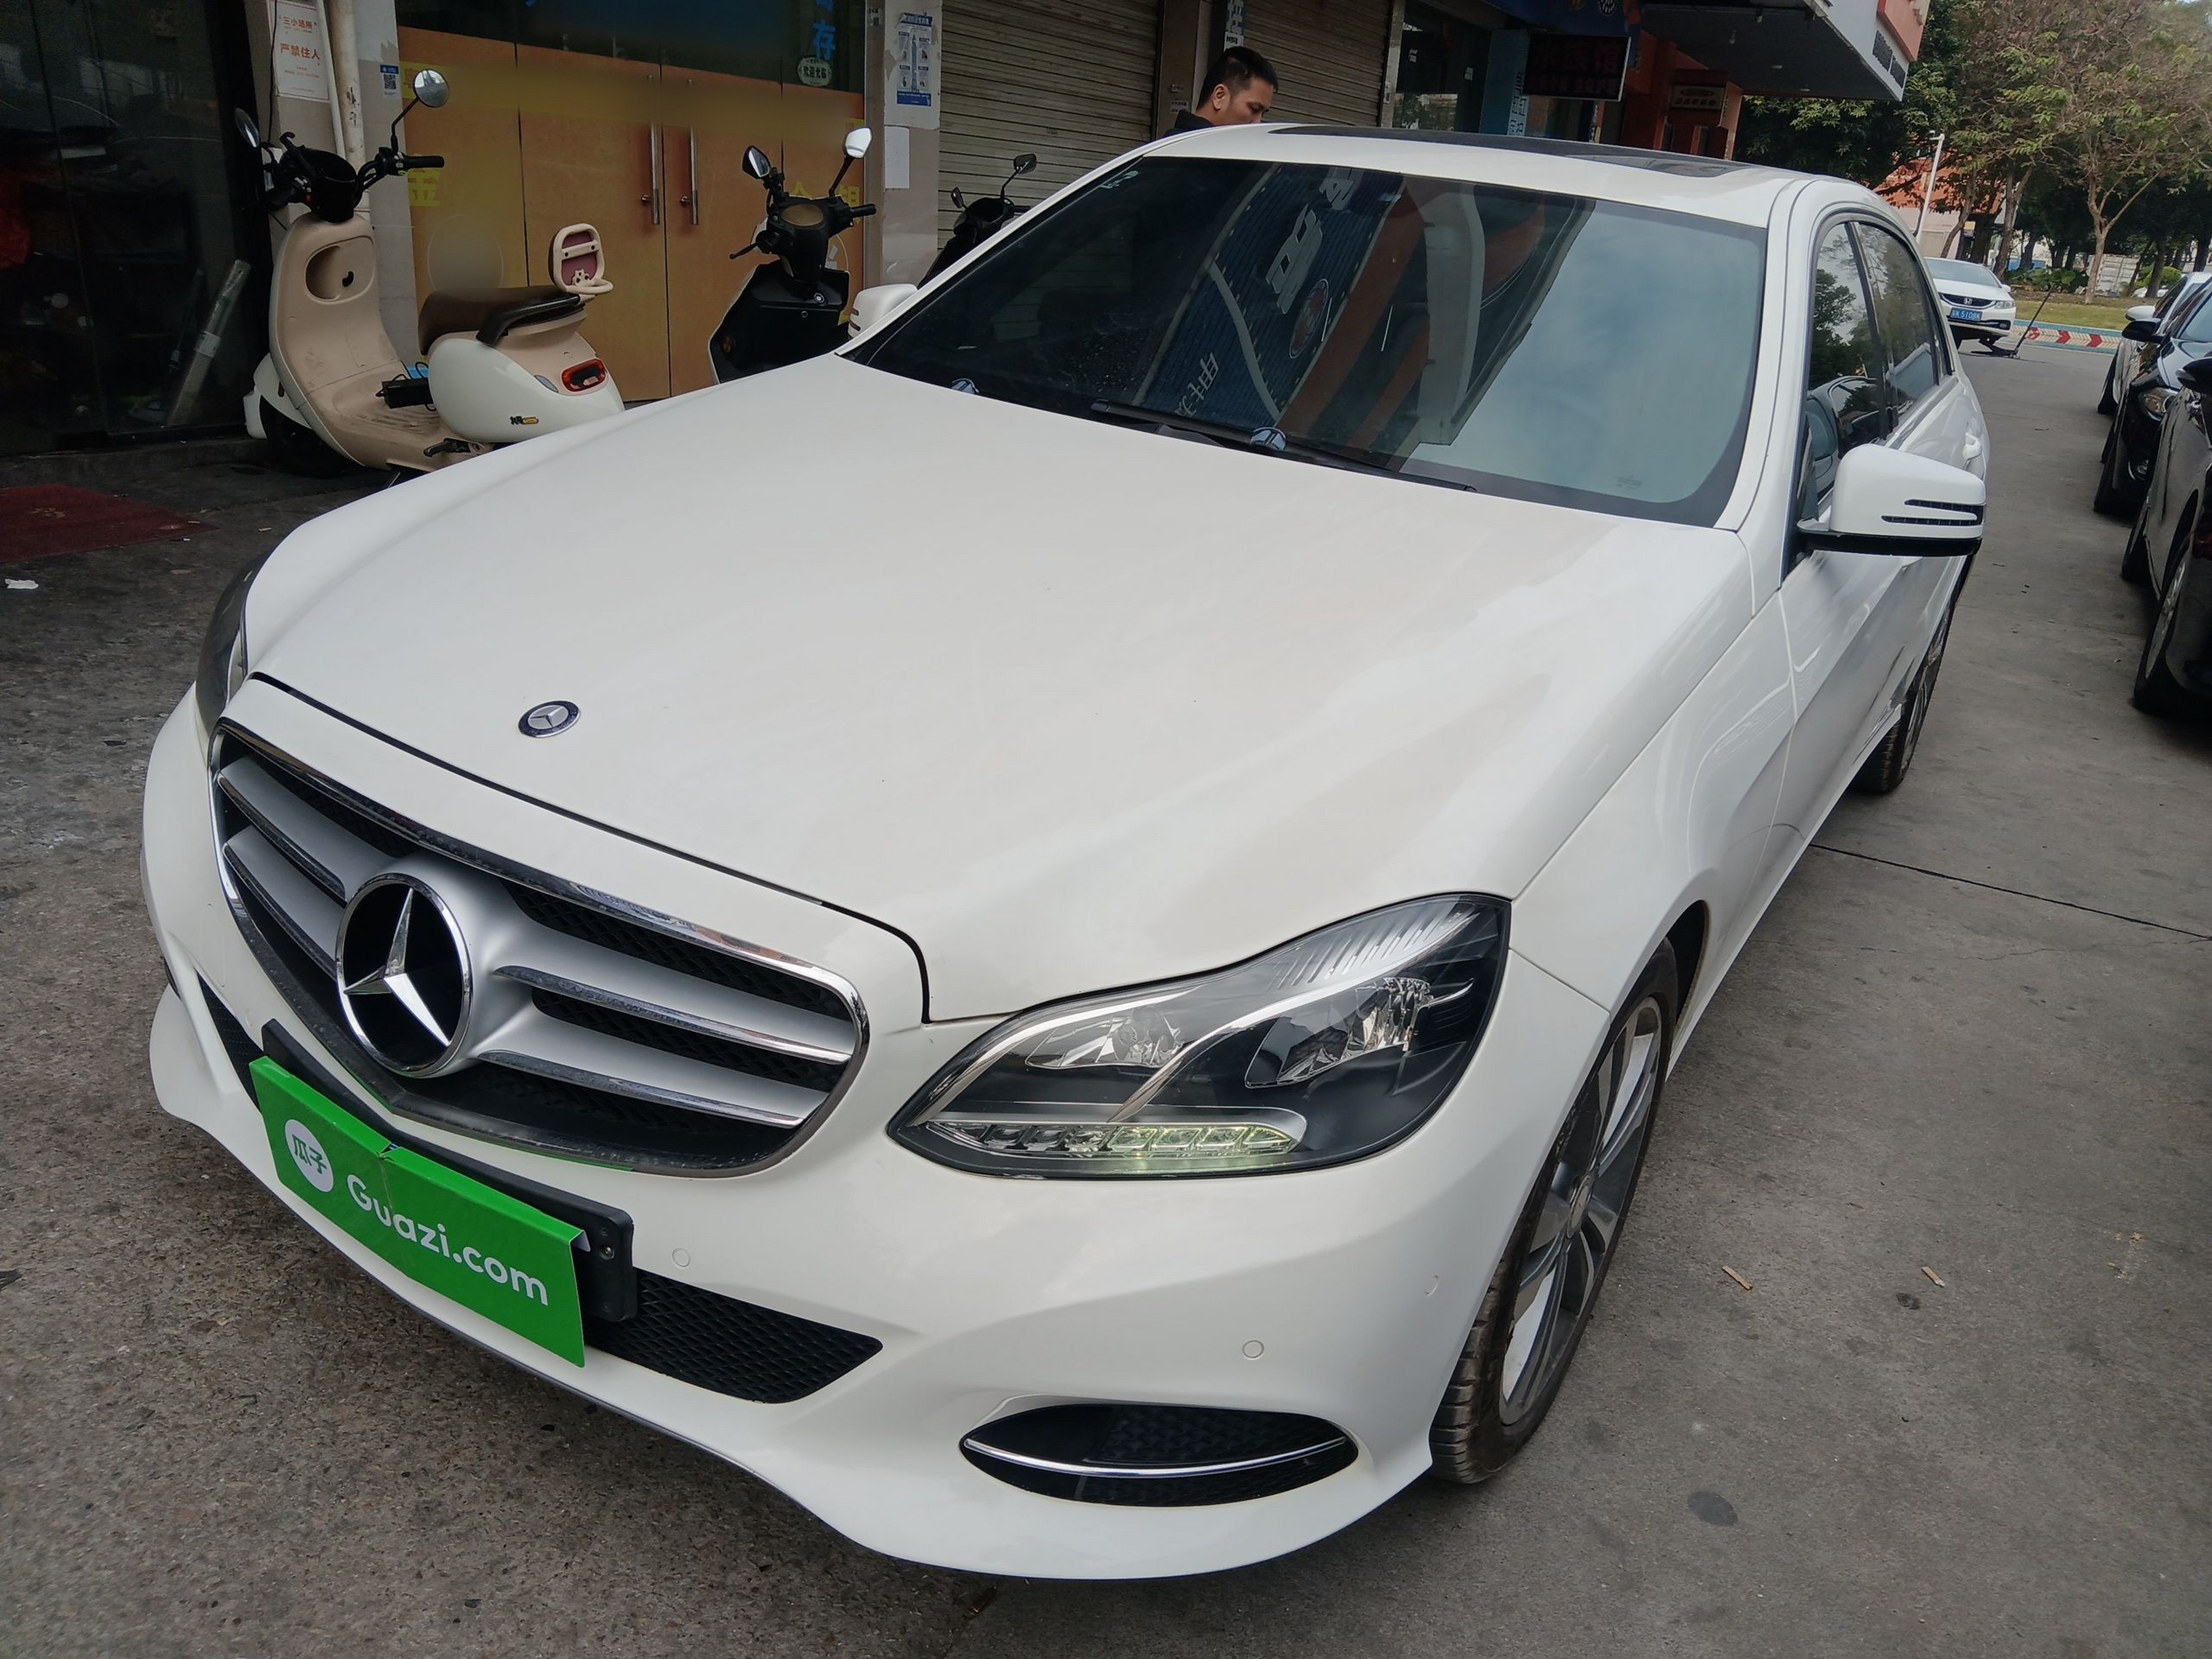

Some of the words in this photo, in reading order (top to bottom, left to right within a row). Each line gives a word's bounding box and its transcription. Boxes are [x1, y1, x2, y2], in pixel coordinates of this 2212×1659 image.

[279, 43, 320, 60] 严禁住人
[291, 1134, 328, 1175] 瓜子
[347, 1174, 549, 1306] Guazi.com
